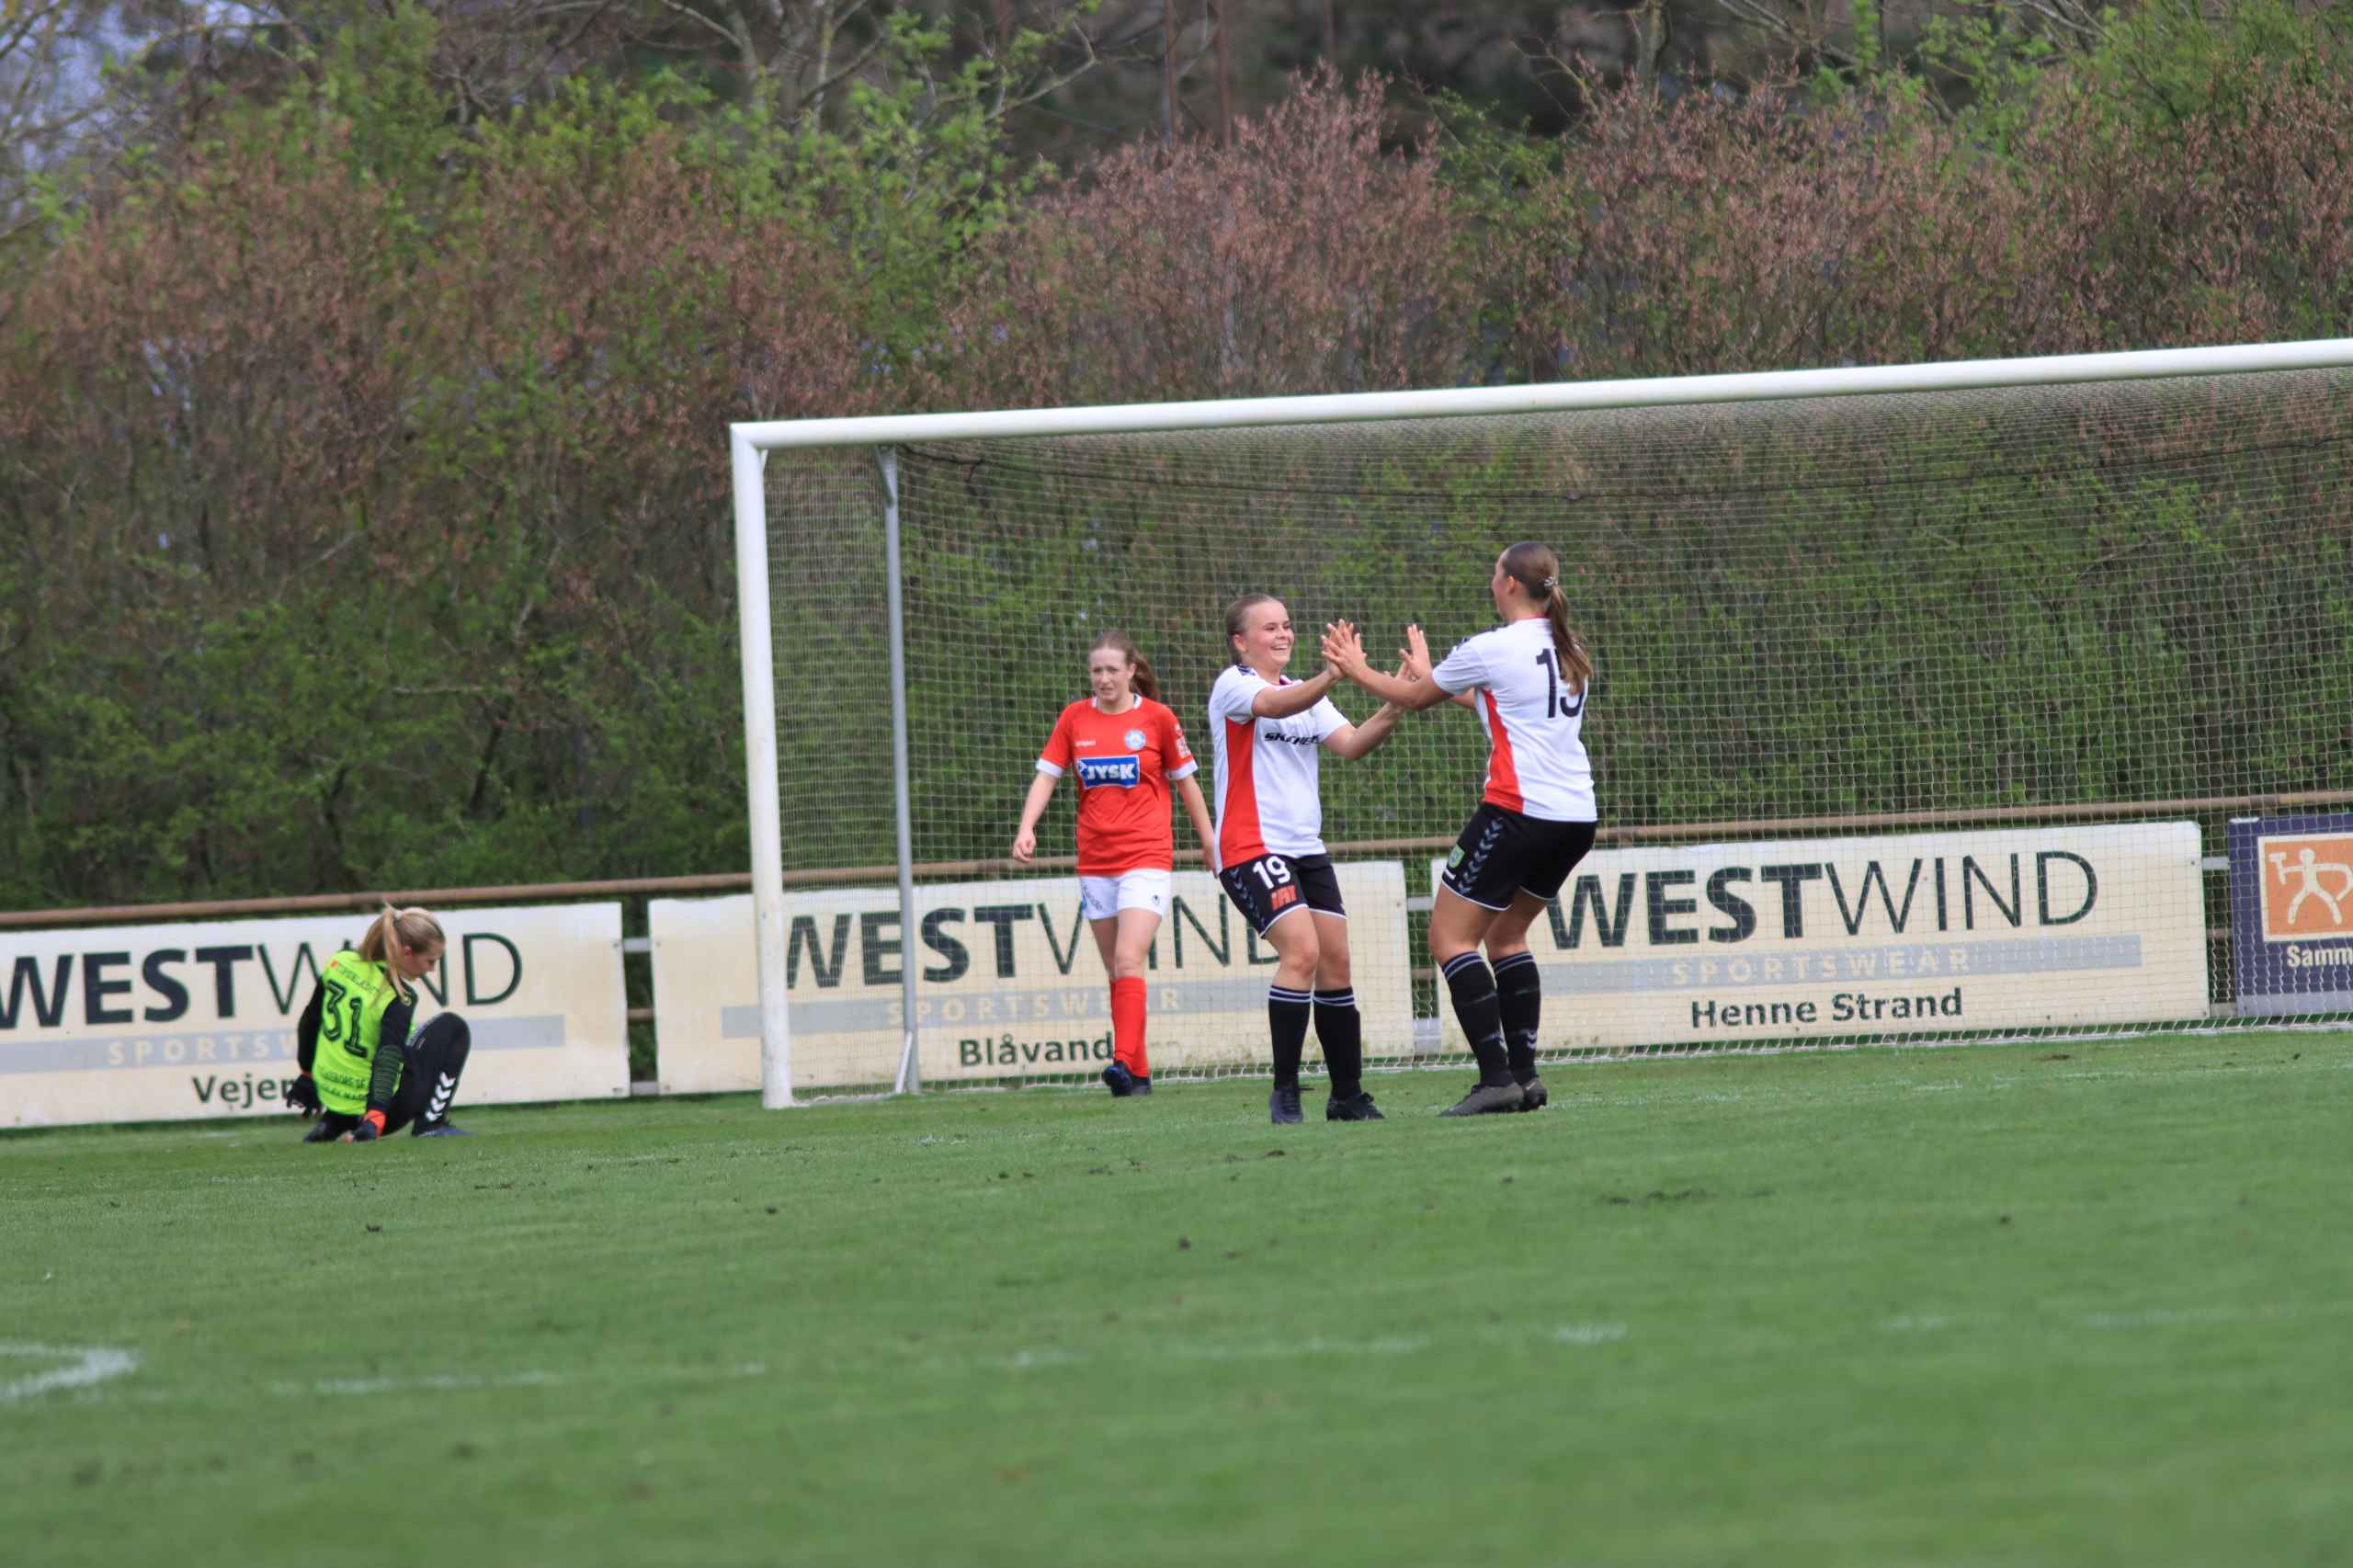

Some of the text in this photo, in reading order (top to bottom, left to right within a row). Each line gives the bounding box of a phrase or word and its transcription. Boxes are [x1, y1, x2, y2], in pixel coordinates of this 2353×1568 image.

[1087, 763, 1136, 780] JYSK
[1253, 856, 1291, 890] 19
[1546, 850, 2098, 950] WESTWIND
[0, 932, 523, 1029] WESTWD
[1673, 948, 1972, 986] SPORTSWEAR
[323, 979, 369, 1059] 31
[888, 987, 1179, 1026] SPORTSWER
[1691, 986, 1962, 1028] Henne Strand
[959, 1031, 1113, 1067] Blåvand
